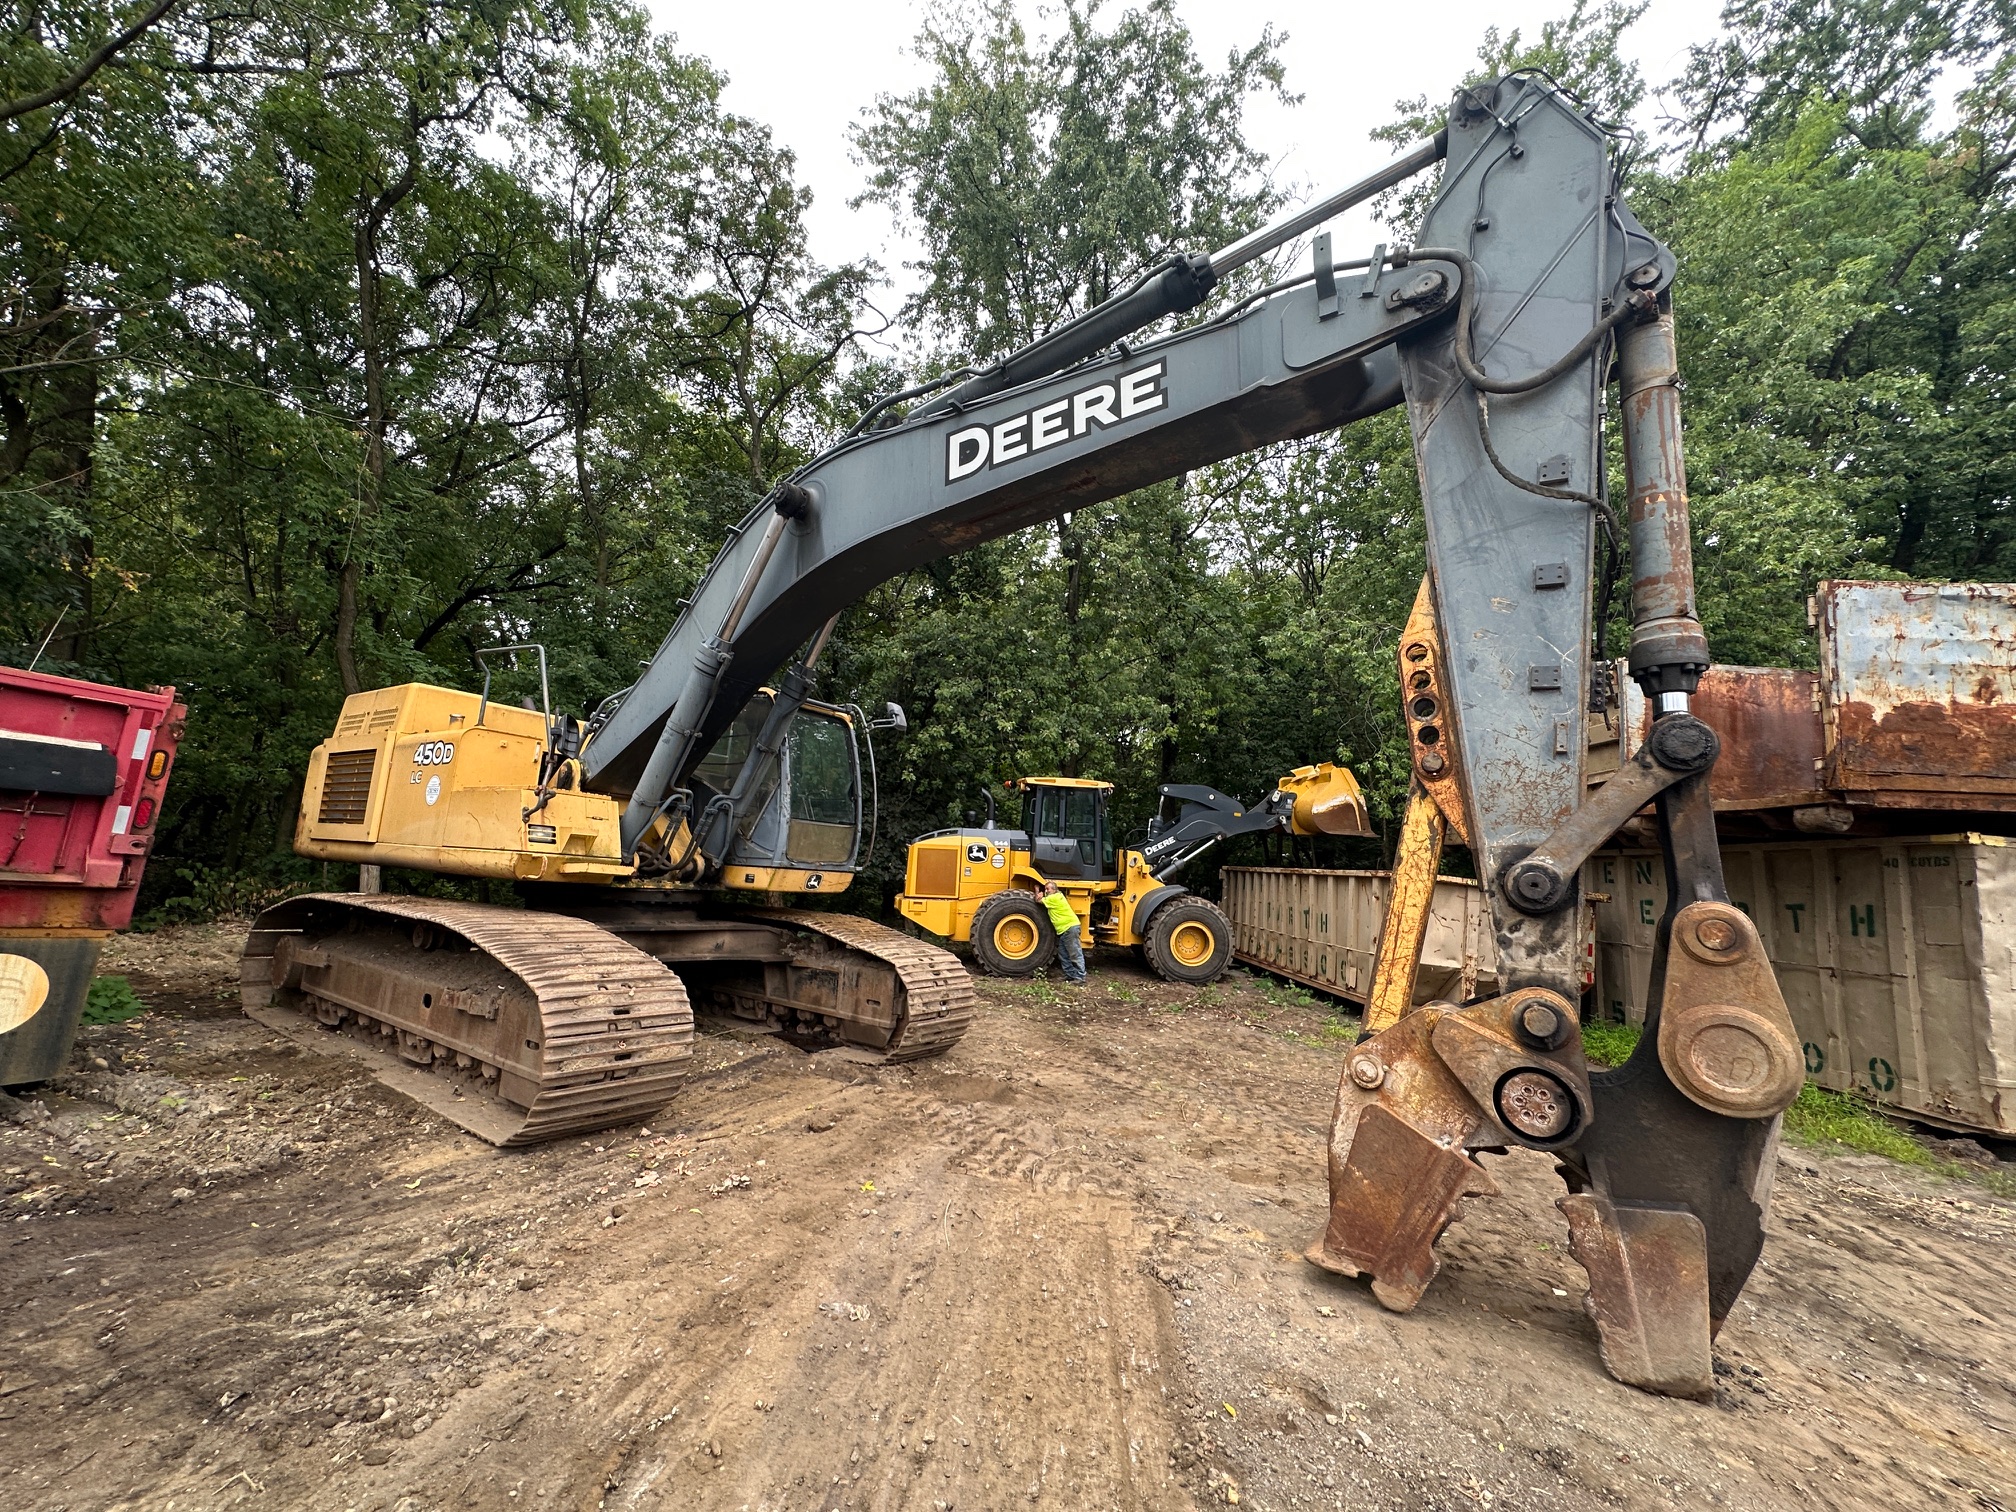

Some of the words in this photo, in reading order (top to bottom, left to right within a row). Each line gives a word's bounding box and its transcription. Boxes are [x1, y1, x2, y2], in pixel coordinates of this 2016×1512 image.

[947, 358, 1166, 483] DEERE
[413, 740, 454, 766] 450D
[410, 770, 423, 784] LC
[1144, 836, 1176, 856] DEERE
[1884, 857, 1899, 868] 40
